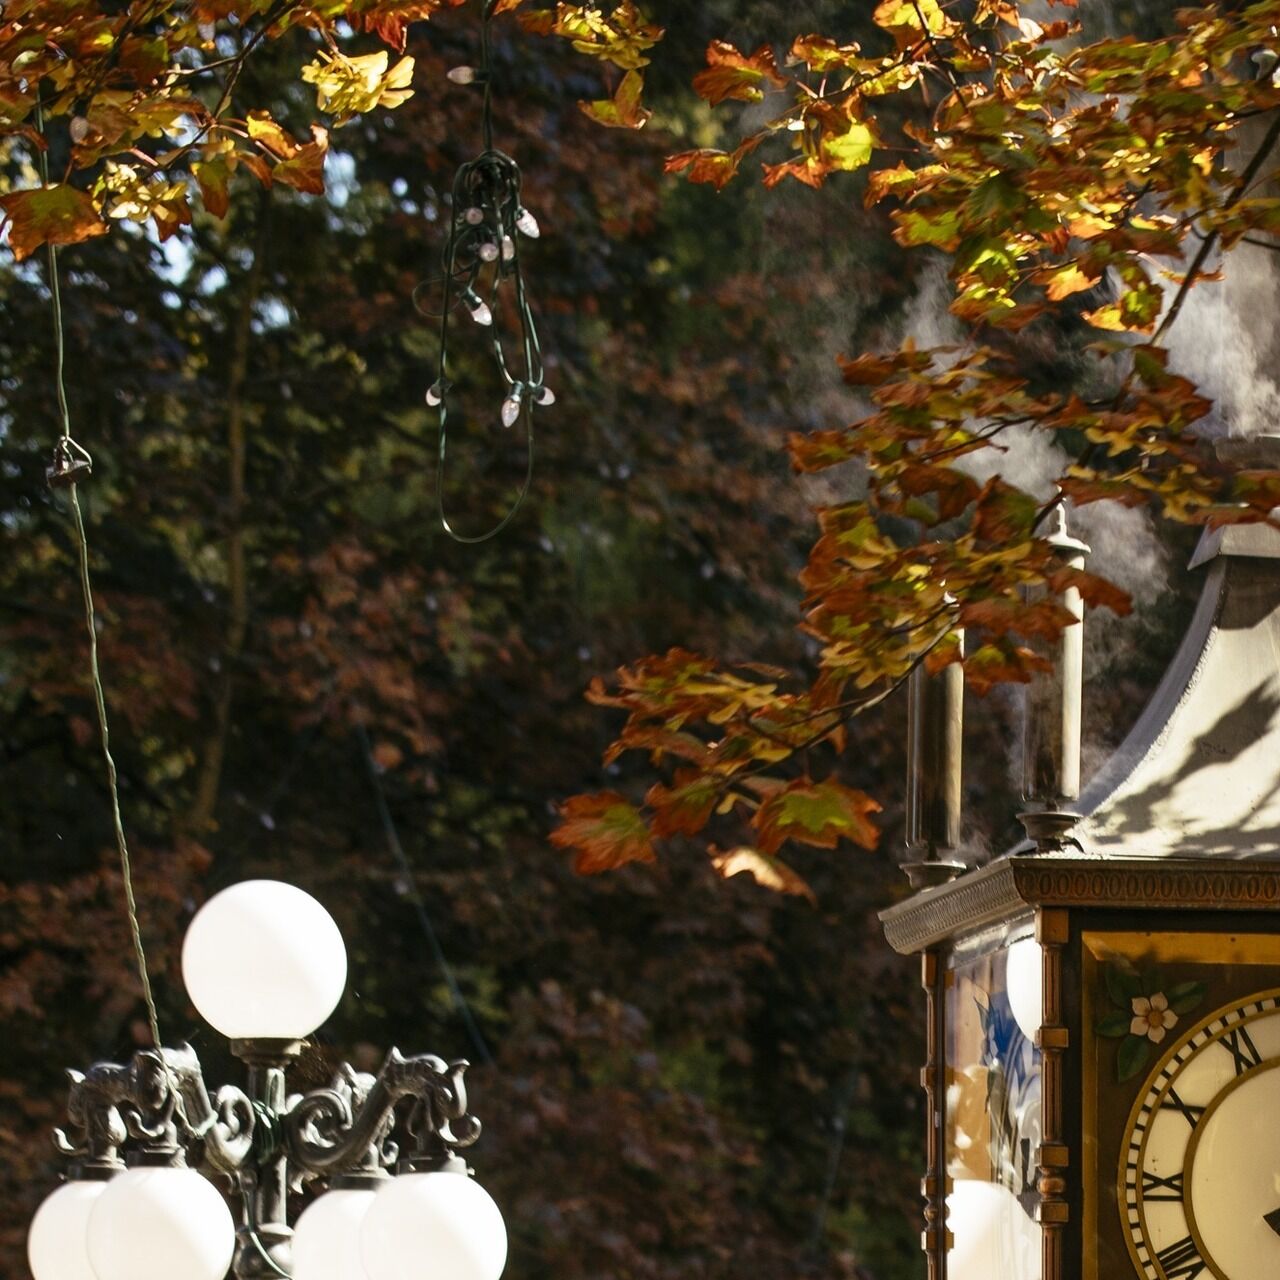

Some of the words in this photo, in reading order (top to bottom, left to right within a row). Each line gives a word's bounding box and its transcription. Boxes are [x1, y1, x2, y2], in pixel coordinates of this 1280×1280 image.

[1219, 1026, 1262, 1076] XI
[1161, 1087, 1206, 1128] X
[1142, 1171, 1184, 1202] IX
